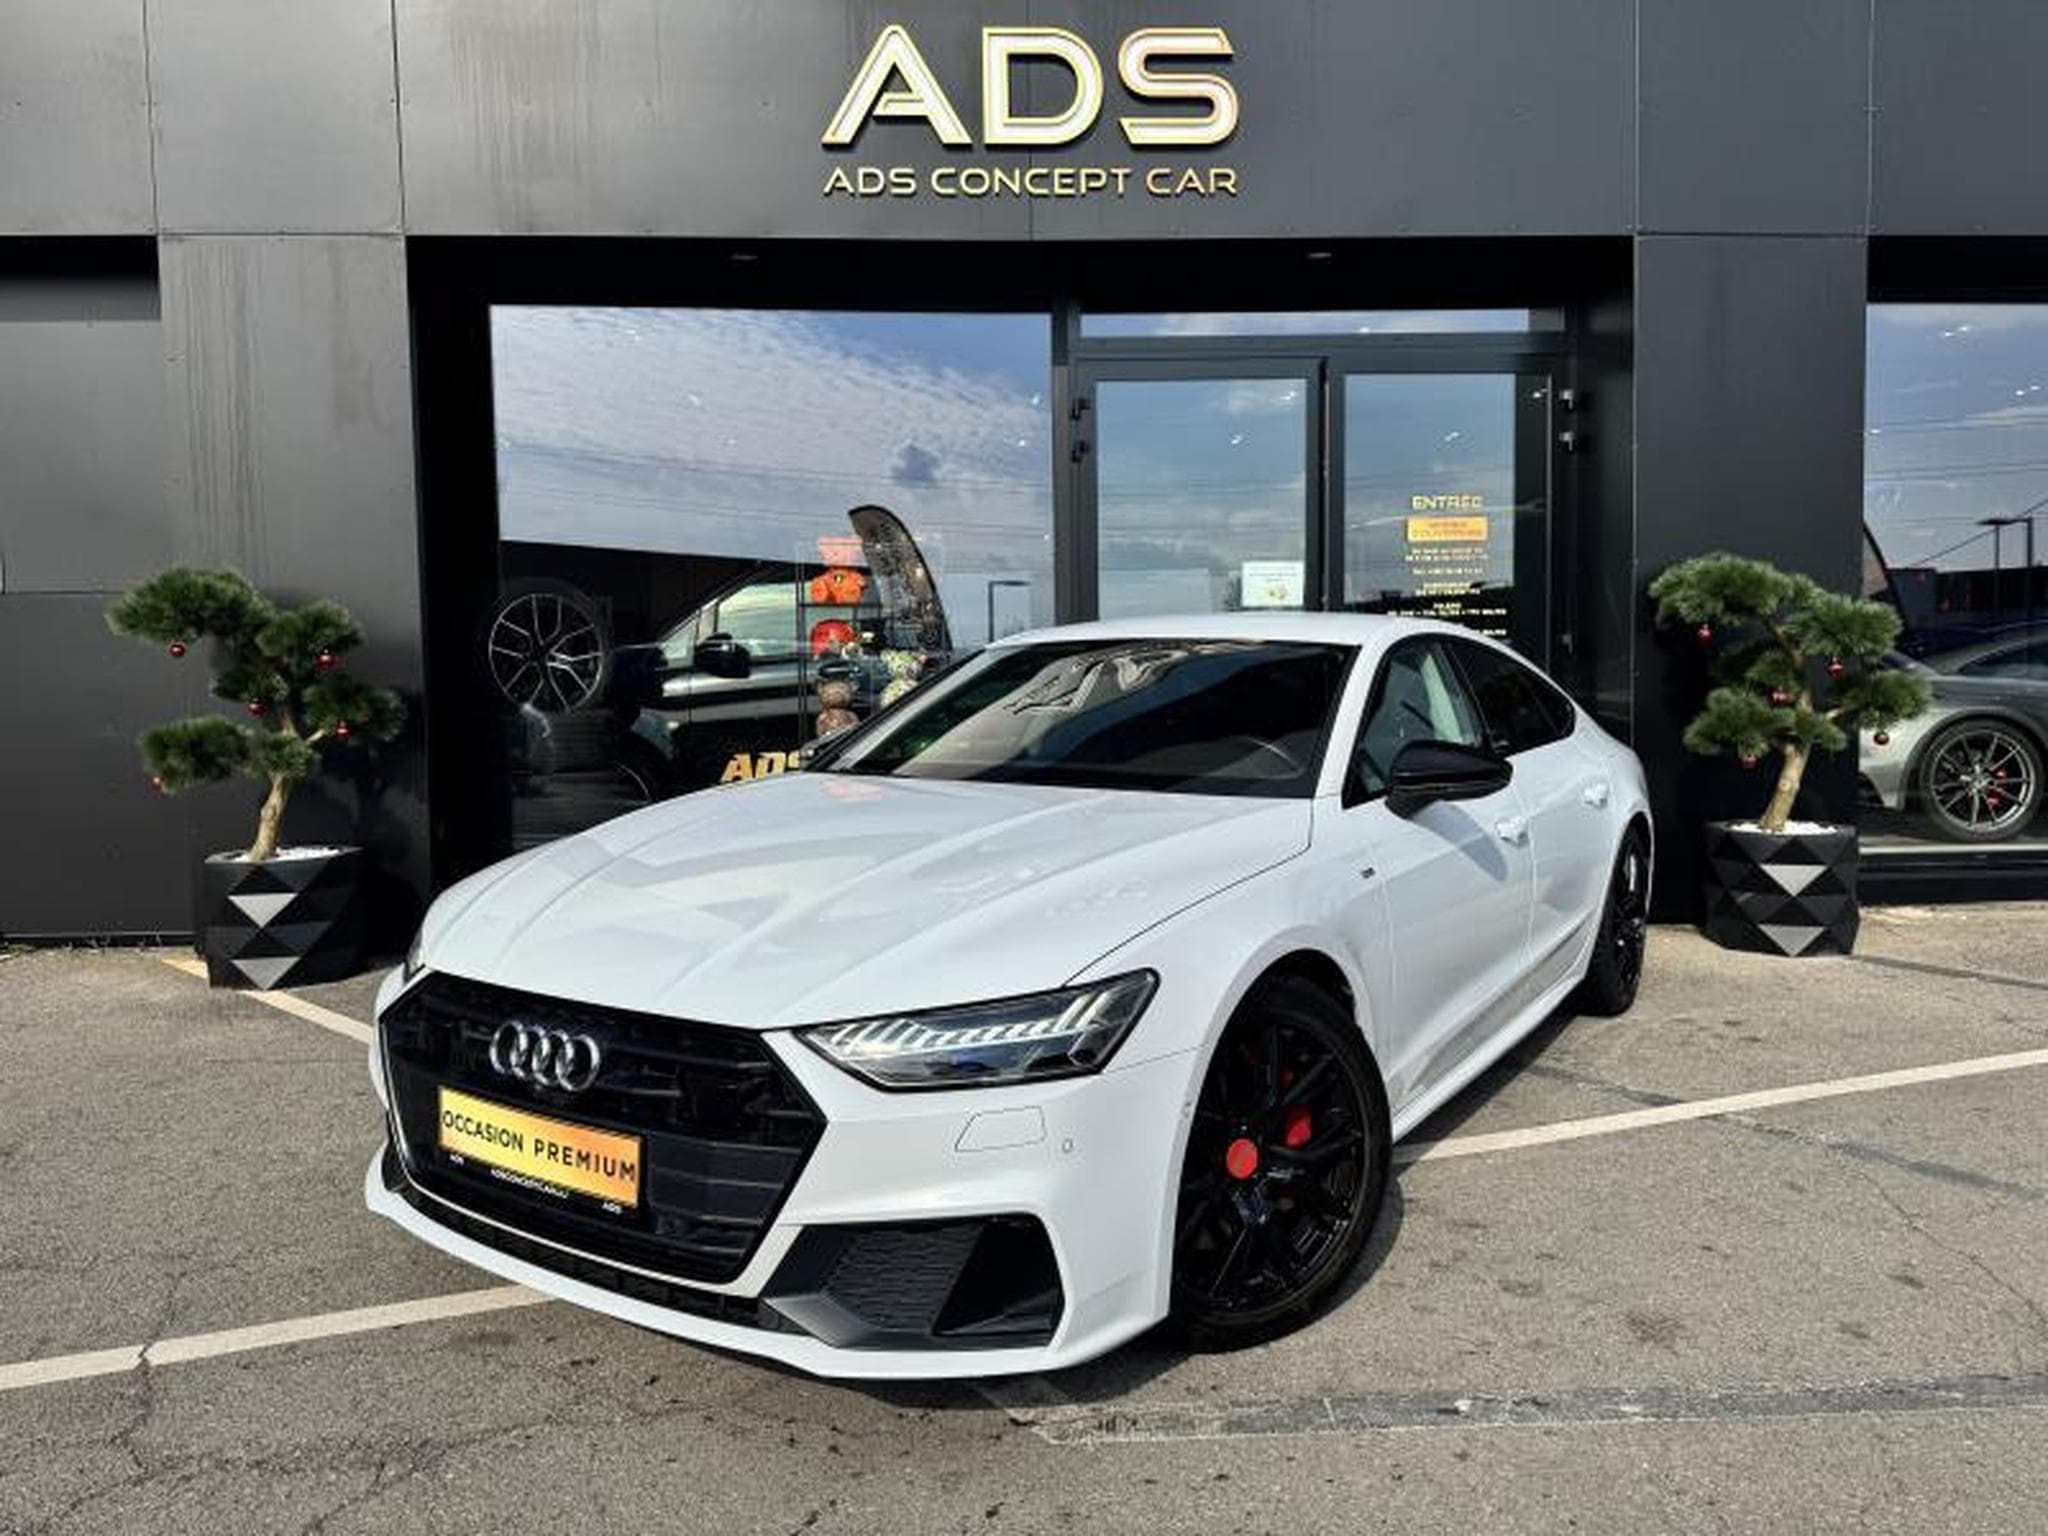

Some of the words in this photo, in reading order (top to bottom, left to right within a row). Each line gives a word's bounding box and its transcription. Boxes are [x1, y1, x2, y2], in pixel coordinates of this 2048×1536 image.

[820, 25, 1240, 147] ADS
[822, 167, 917, 196] ADS
[930, 167, 1132, 197] CONCEPT
[1146, 167, 1239, 196] CAR
[442, 1110, 524, 1153] OCCASION
[533, 1138, 635, 1182] PREMIUM
